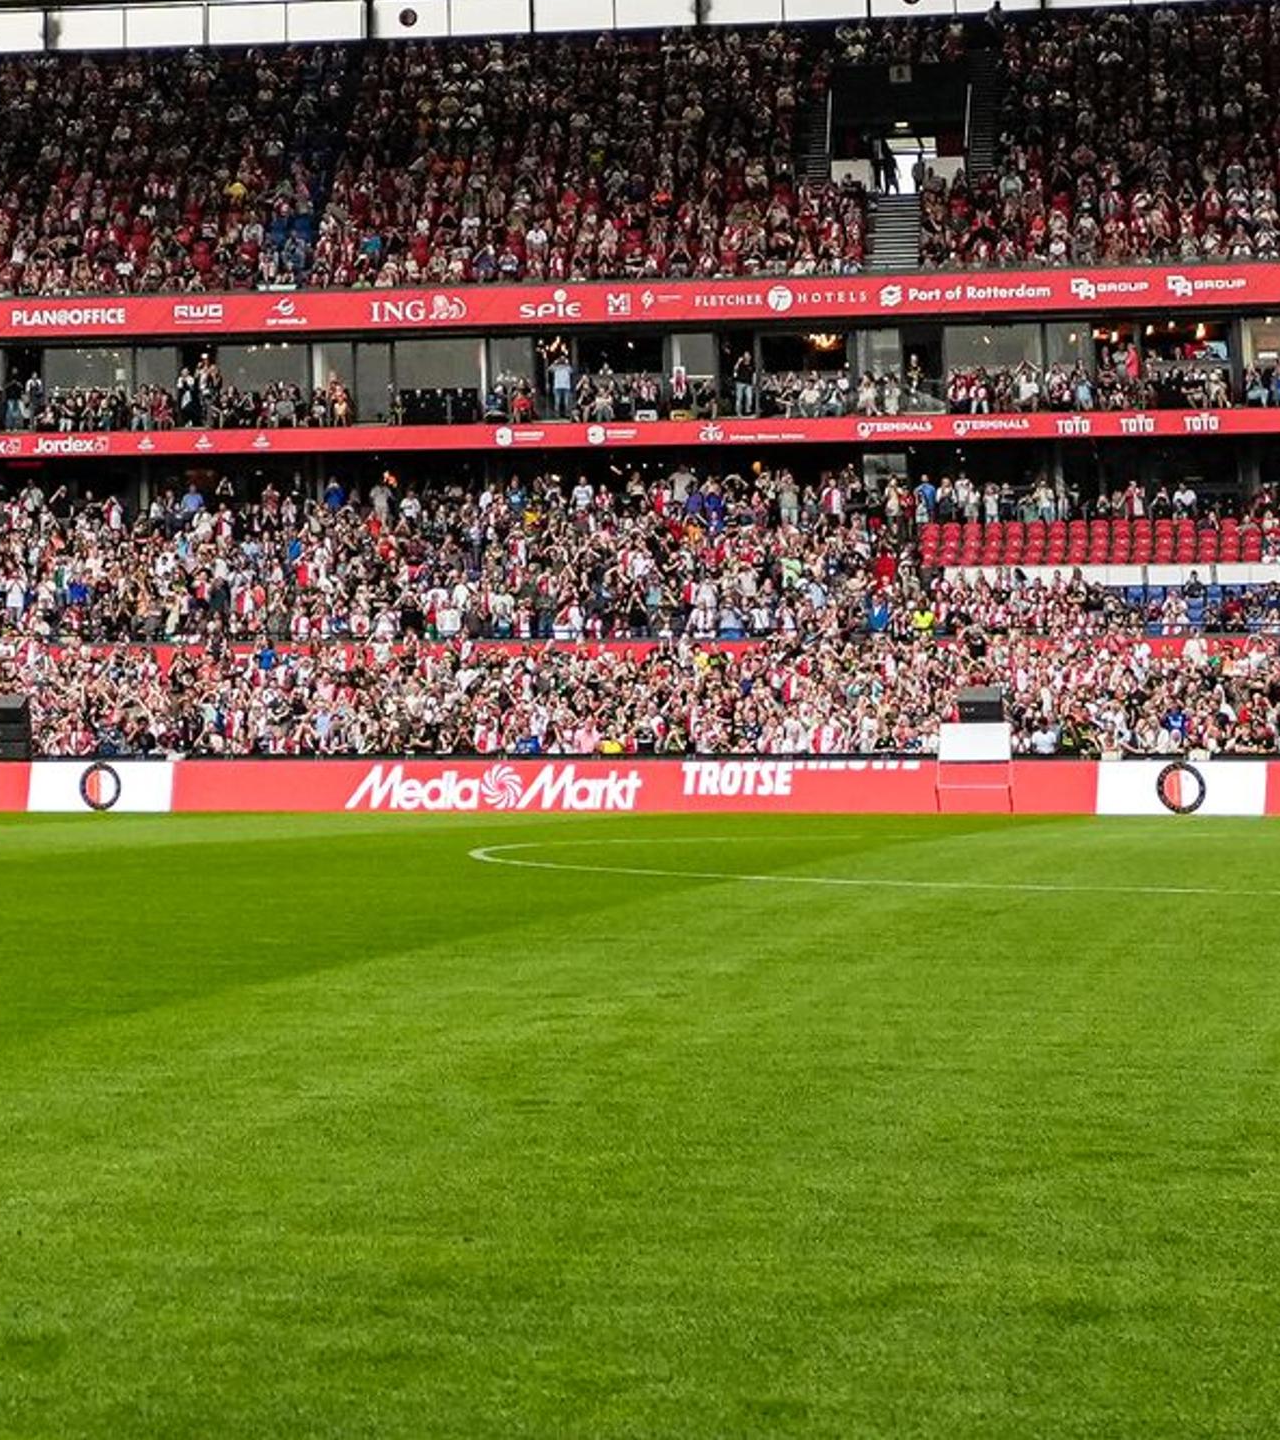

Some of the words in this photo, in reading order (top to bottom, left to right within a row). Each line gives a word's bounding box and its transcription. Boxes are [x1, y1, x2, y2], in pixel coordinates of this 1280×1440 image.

[908, 288, 941, 301] Port
[945, 285, 962, 300] of
[966, 283, 1051, 299] Rotterdam
[1097, 281, 1149, 293] GROUP
[1194, 278, 1247, 290] GROUP
[694, 294, 763, 307] FLETCHER
[797, 291, 867, 303] HOTELS
[371, 300, 426, 322] ING
[1056, 416, 1091, 434] TOTO
[1120, 415, 1155, 433] TOTO
[1183, 413, 1219, 431] TOTO
[33, 436, 93, 454] Jordex
[344, 764, 481, 810] Media
[517, 764, 643, 810] Markt
[681, 762, 793, 796] TROTSE
